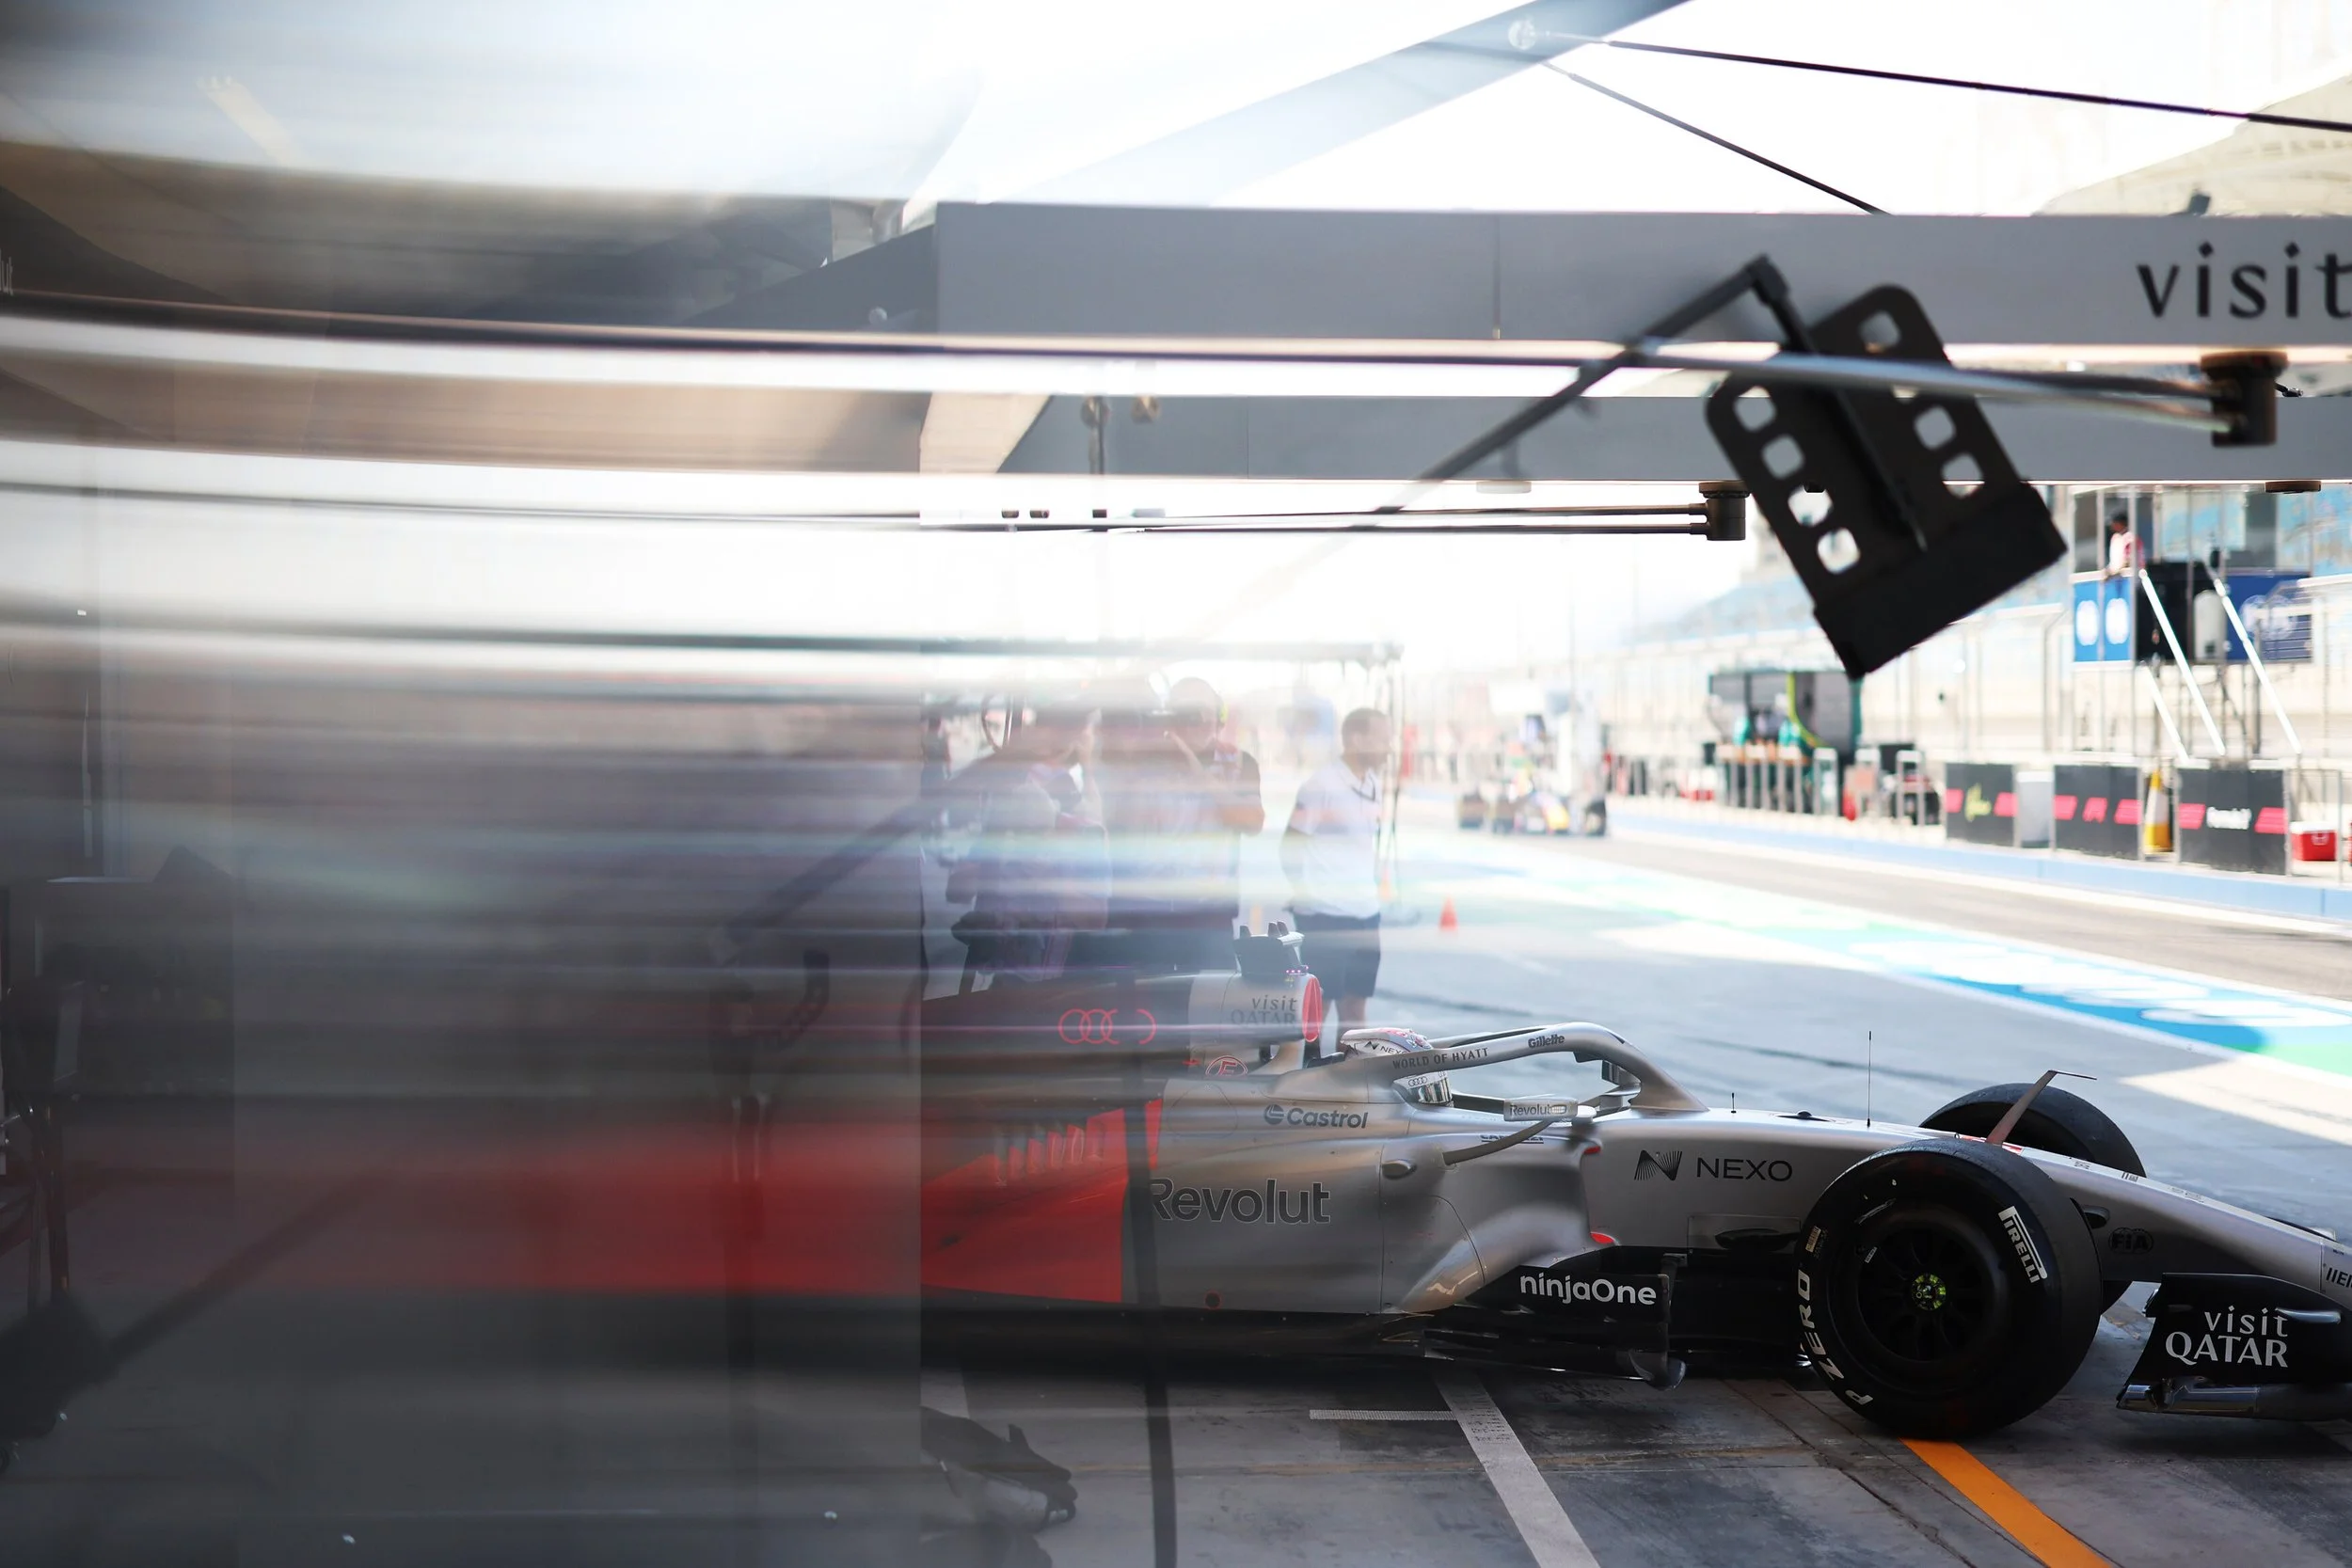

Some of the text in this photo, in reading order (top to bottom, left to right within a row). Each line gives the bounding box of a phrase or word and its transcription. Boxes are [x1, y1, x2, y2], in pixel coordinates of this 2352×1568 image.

[2136, 241, 2352, 319] visit
[1251, 994, 1297, 1012] visit
[1527, 1034, 1565, 1049] Gillette
[1392, 1047, 1489, 1069] WORLD OF HYATT
[1286, 1107, 1369, 1129] Castrol
[1509, 1103, 1552, 1117] Revolut
[1696, 1157, 1793, 1182] NEXO
[1150, 1177, 1331, 1224] Revolut
[1998, 1205, 2047, 1283] PIRELLI
[1519, 1272, 1657, 1306] ninjaOne
[1798, 1269, 1845, 1381] ZERO
[2203, 1305, 2289, 1338] visit
[2165, 1331, 2289, 1368] QATAR
[1845, 1389, 1873, 1405] P
